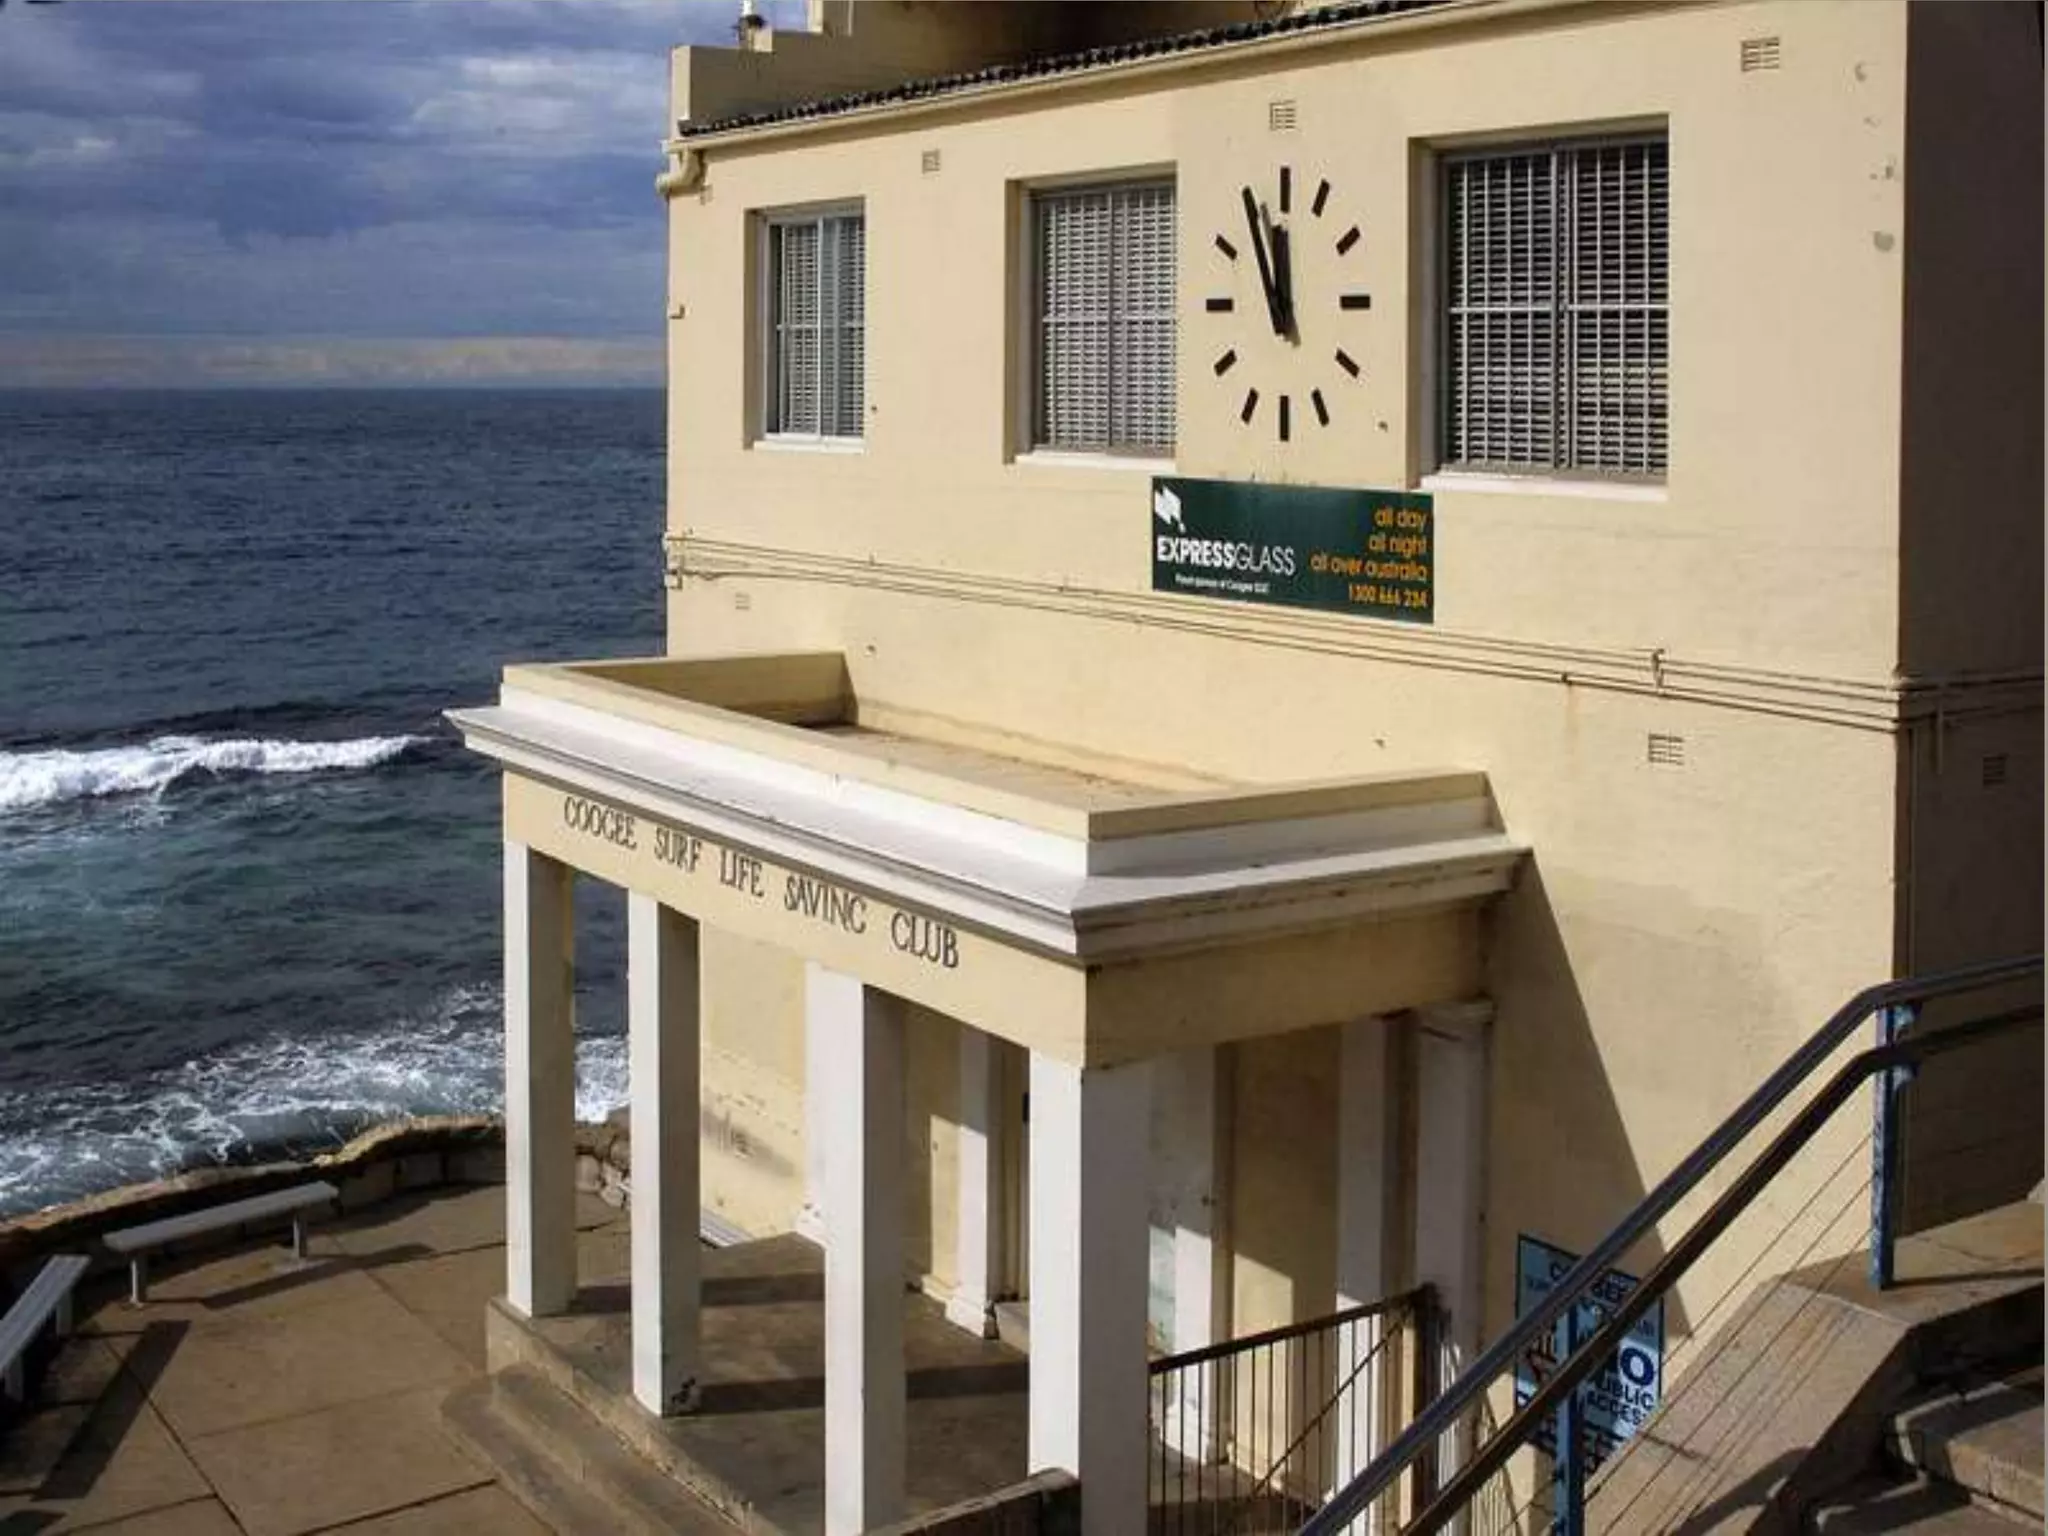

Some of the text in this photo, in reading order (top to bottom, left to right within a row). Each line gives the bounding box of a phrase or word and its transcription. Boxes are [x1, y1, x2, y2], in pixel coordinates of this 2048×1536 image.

[1374, 506, 1427, 532] all day
[1157, 537, 1295, 576] EXPRESSGLASS
[1368, 532, 1427, 559] all night
[1331, 557, 1362, 576] over
[1365, 560, 1428, 583] australia
[653, 827, 702, 873] SURF
[720, 848, 766, 898] LIFE
[890, 910, 960, 969] CLUB
